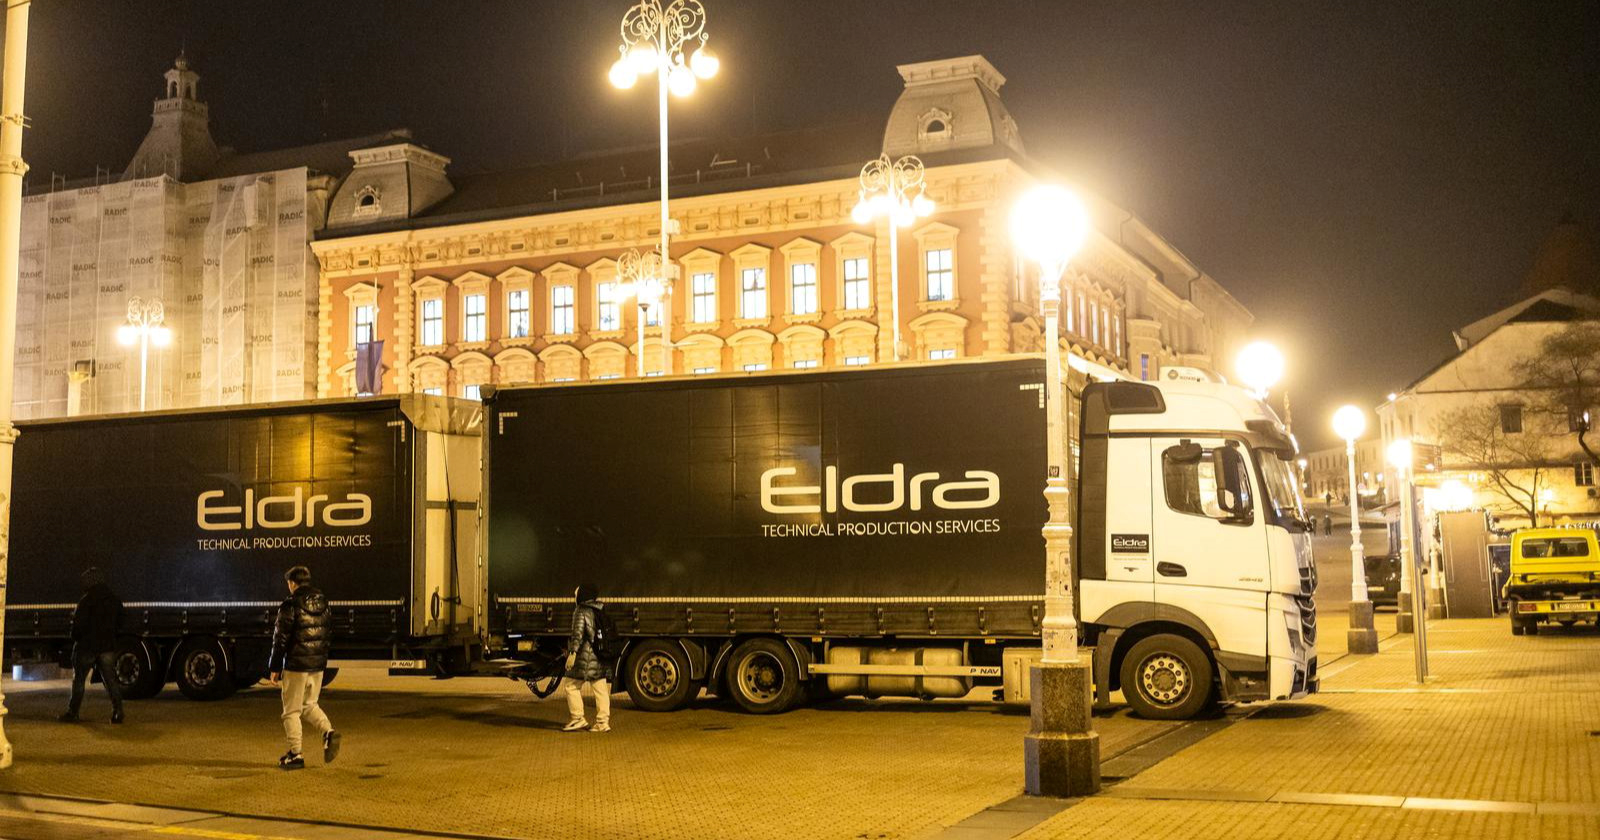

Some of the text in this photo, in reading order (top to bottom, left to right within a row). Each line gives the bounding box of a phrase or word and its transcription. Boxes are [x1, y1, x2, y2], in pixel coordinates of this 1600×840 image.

[760, 463, 1001, 514] Eldra
[197, 486, 372, 531] Eldra
[761, 519, 1001, 538] TECHNICAL PRODUCTION SERVICES
[197, 534, 372, 551] TECHNICAL PRODUCTION SERVICES
[1113, 538, 1148, 547] Eldra
